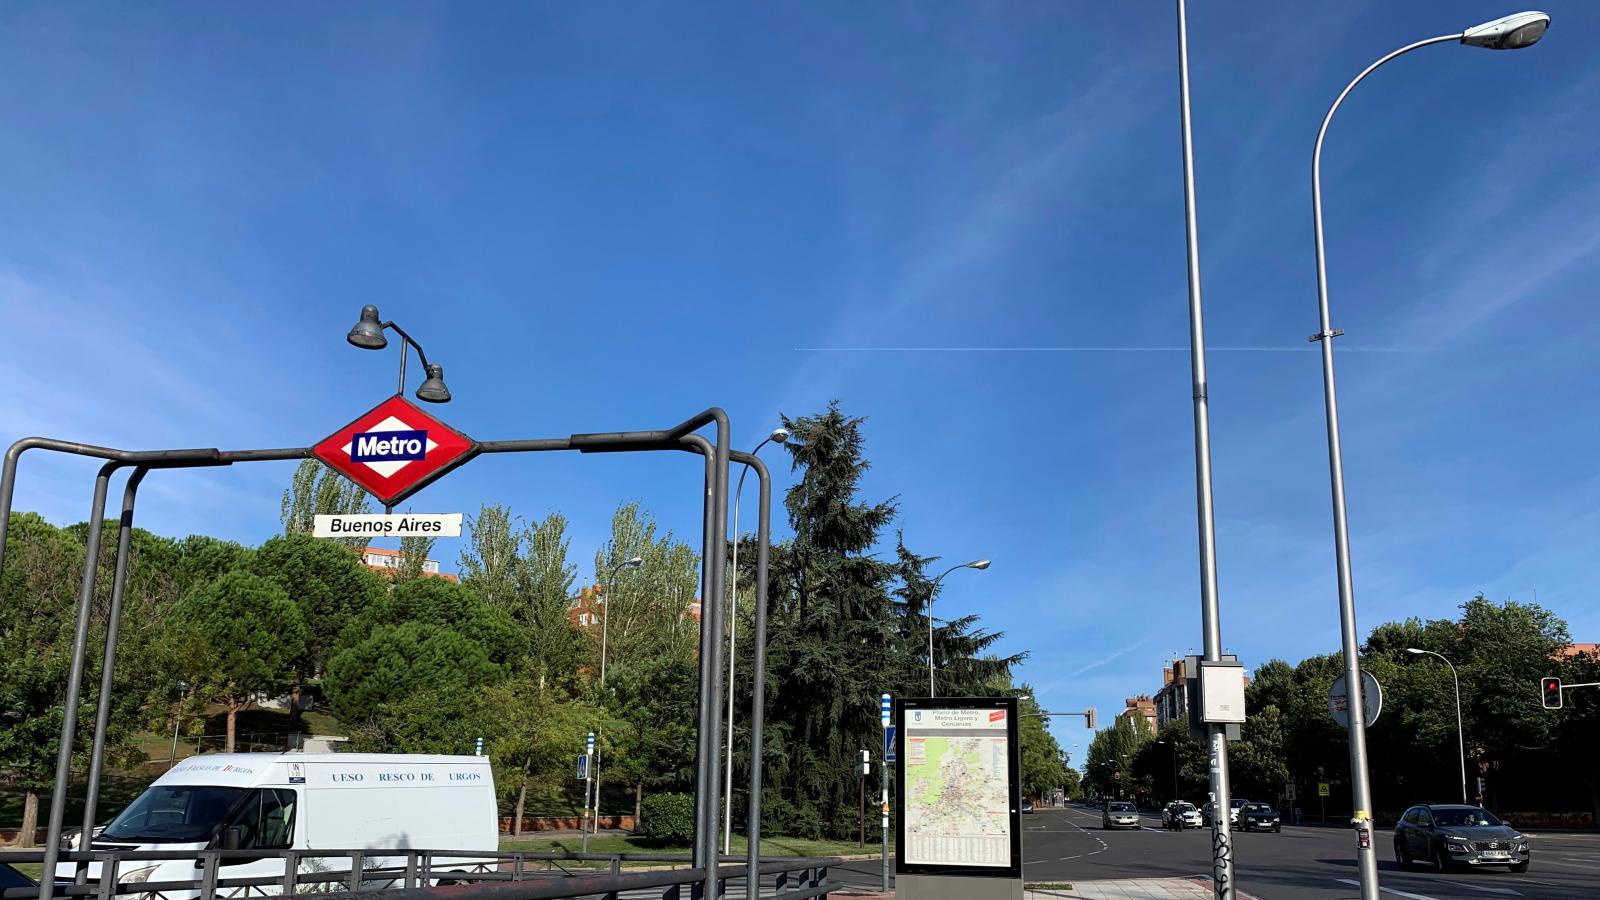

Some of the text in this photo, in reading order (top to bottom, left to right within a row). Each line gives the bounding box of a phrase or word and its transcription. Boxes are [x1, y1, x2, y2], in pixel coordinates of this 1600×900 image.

[357, 436, 422, 457] Metro
[330, 517, 442, 533] Buenos Aires
[378, 772, 415, 782] RESCO
[420, 772, 435, 781] DE
[449, 772, 481, 781] URGOS
